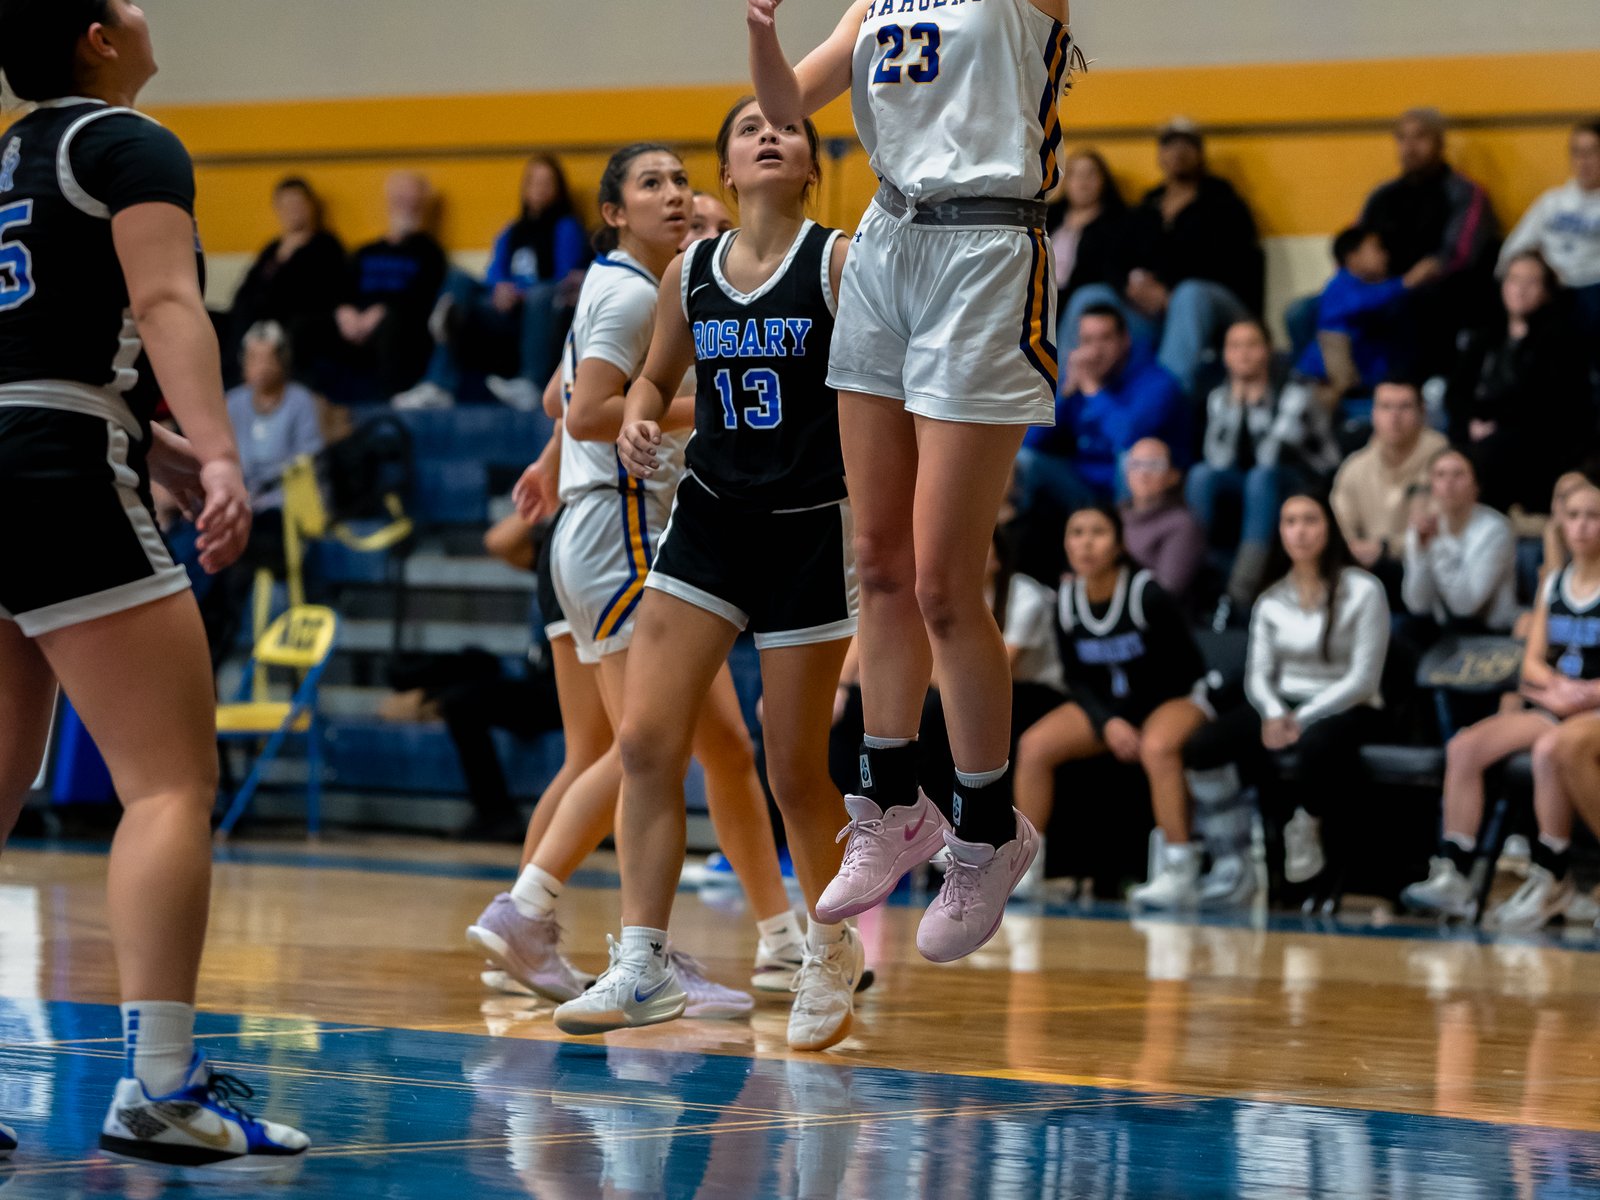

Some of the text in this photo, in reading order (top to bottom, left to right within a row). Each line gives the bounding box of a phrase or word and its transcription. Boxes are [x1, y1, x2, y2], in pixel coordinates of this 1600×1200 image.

[872, 21, 941, 85] 23
[693, 318, 812, 360] ROSARY
[714, 367, 782, 429] 13
